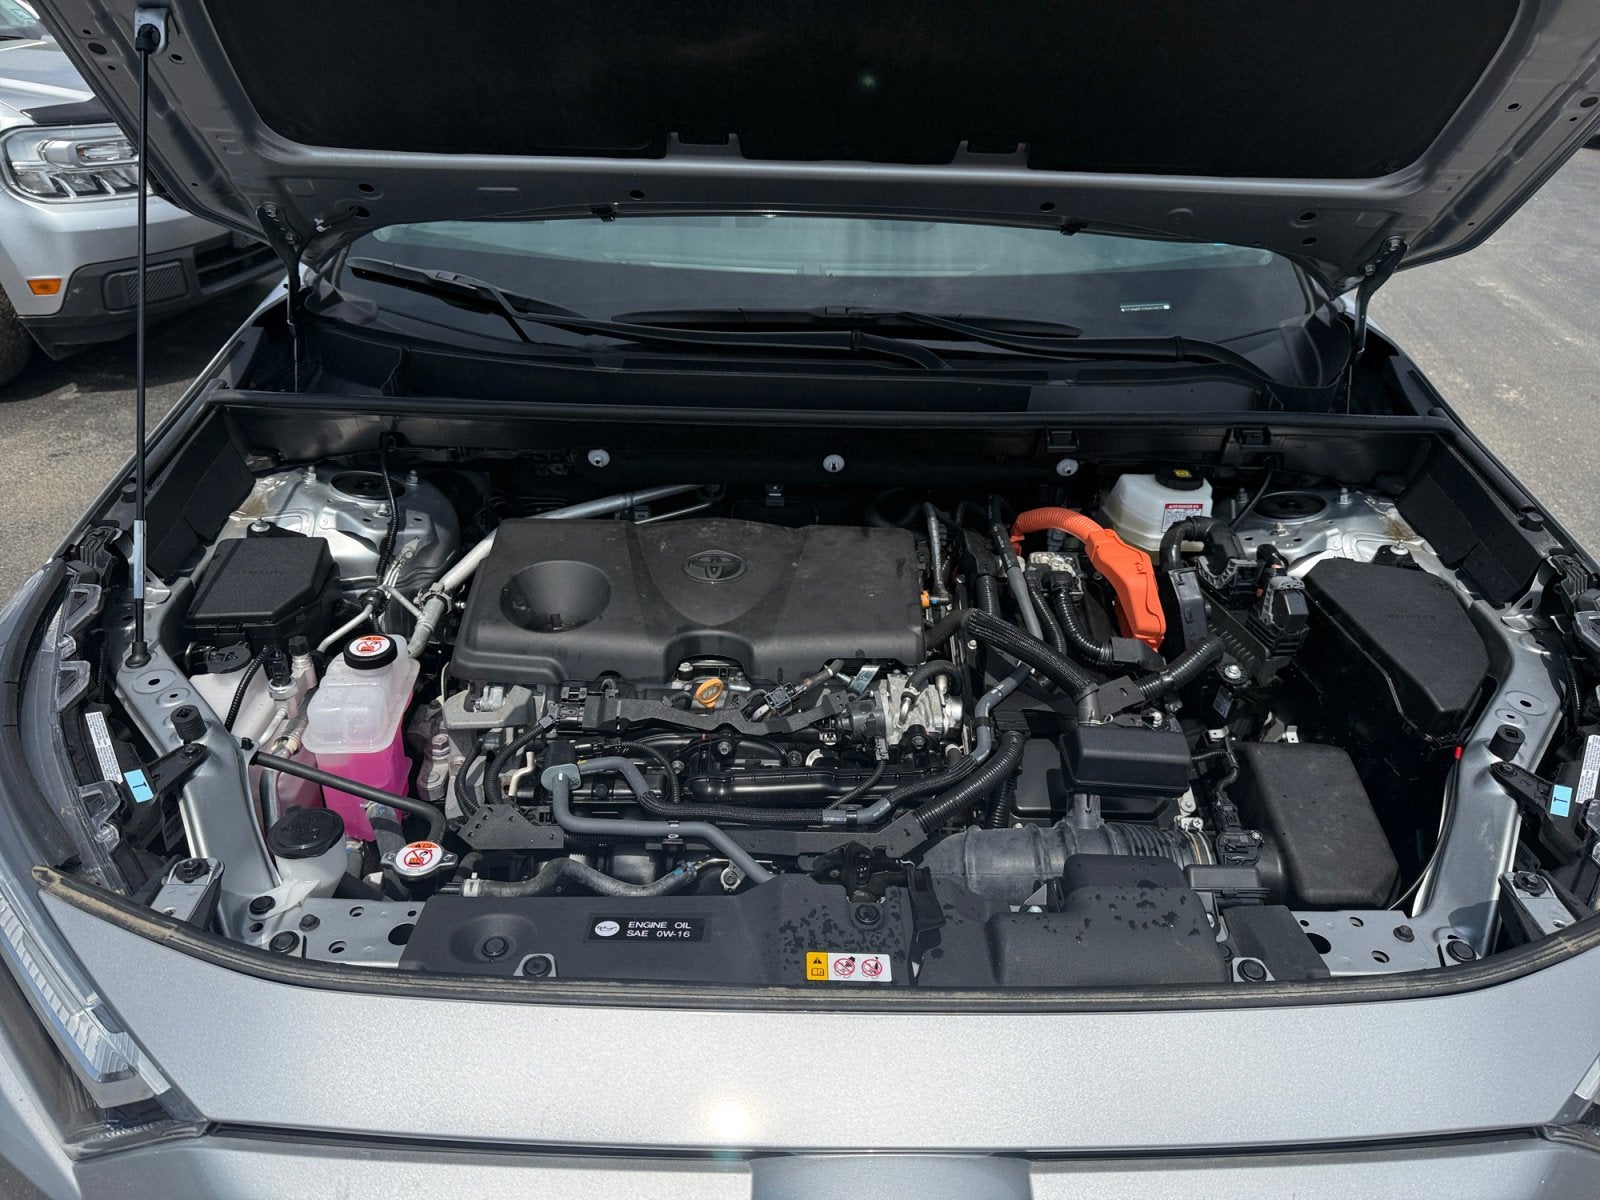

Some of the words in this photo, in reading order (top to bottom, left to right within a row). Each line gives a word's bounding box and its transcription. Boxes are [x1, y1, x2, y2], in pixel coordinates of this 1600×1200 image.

[627, 921, 668, 929] ENGINE
[674, 921, 692, 929] OIL
[626, 929, 649, 937] SAE
[656, 930, 691, 938] 0W-16
